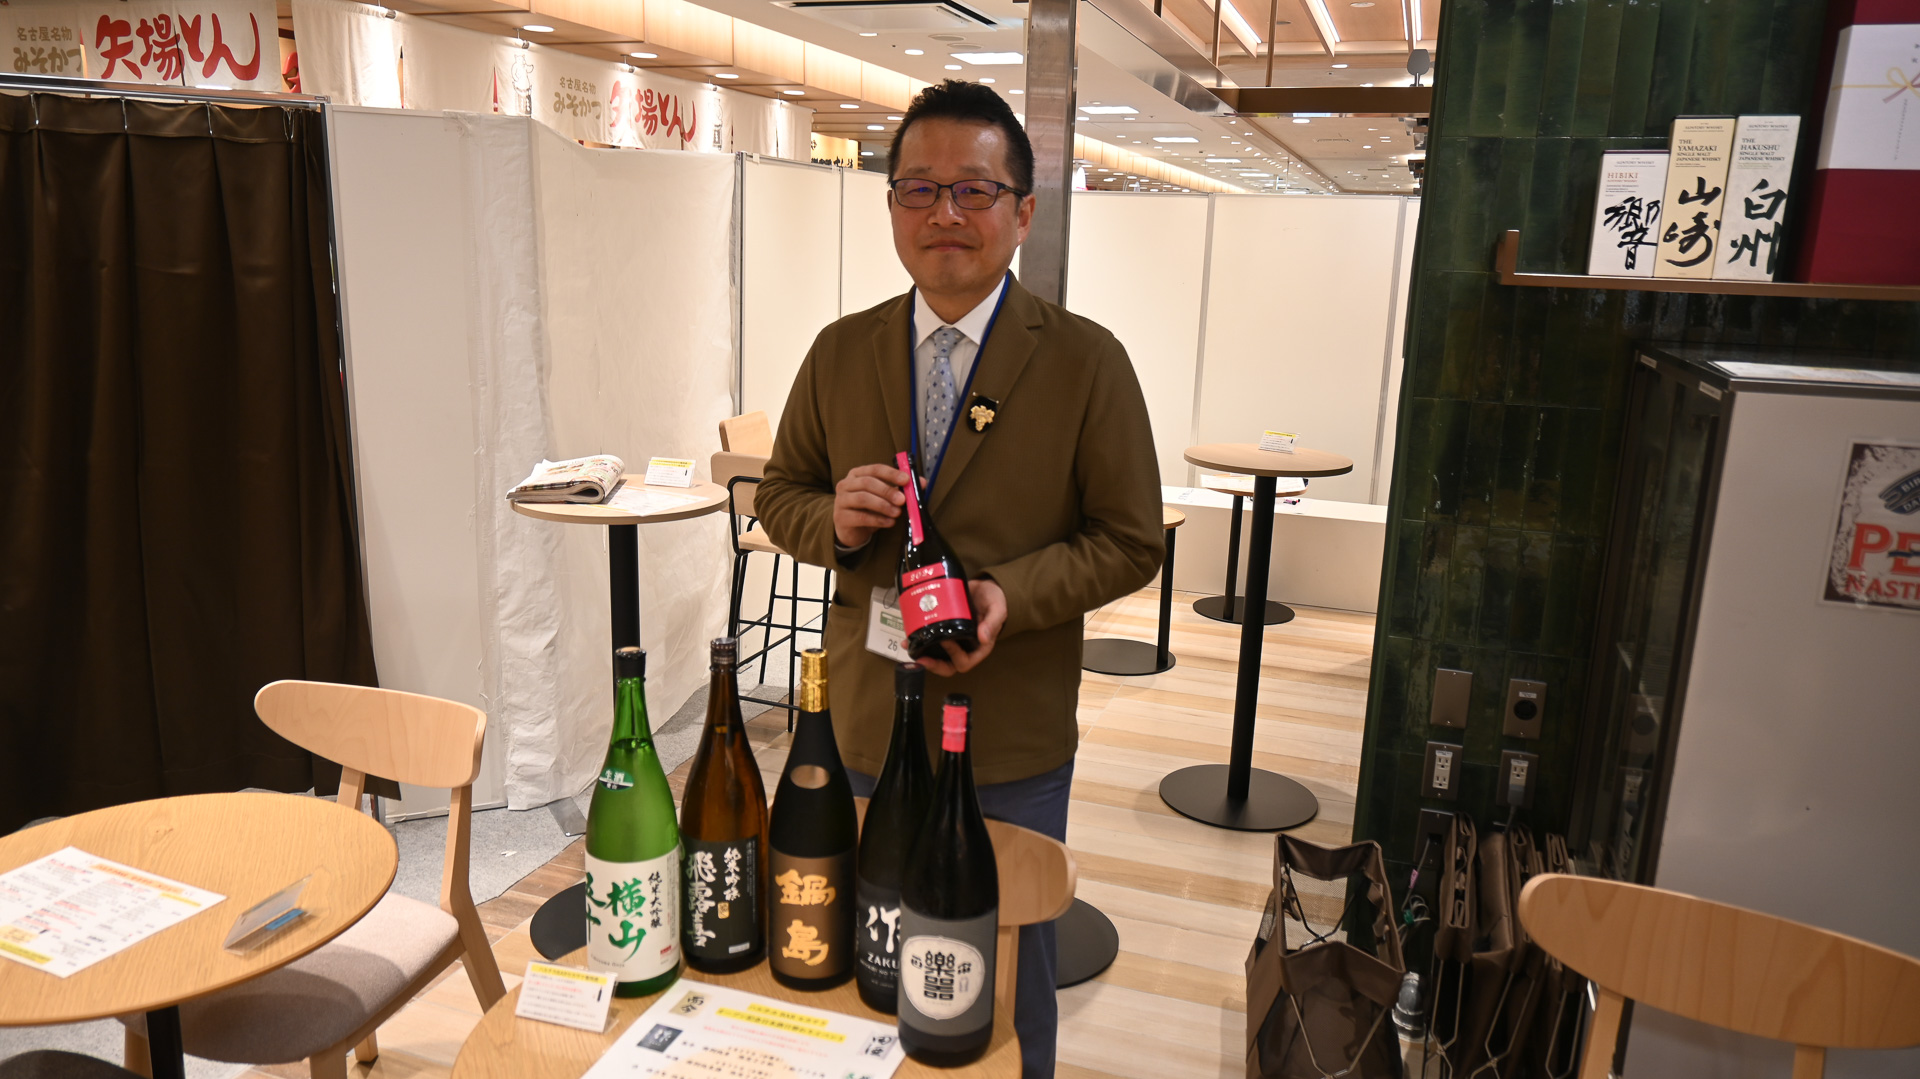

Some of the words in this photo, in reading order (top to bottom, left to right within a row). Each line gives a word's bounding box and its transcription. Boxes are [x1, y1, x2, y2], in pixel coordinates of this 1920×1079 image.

[17, 27, 72, 41] 名古屋名物
[96, 12, 261, 81] 矢場とん
[13, 46, 82, 74] みそかつ
[559, 76, 597, 95] 名古屋名物
[553, 91, 602, 120] みそかつ
[1603, 196, 1661, 271] 響
[1727, 178, 1788, 275] 白州
[887, 638, 898, 652] 26
[605, 769, 625, 783] 生酒
[603, 877, 647, 963] 横山
[775, 869, 836, 967] 鍋島
